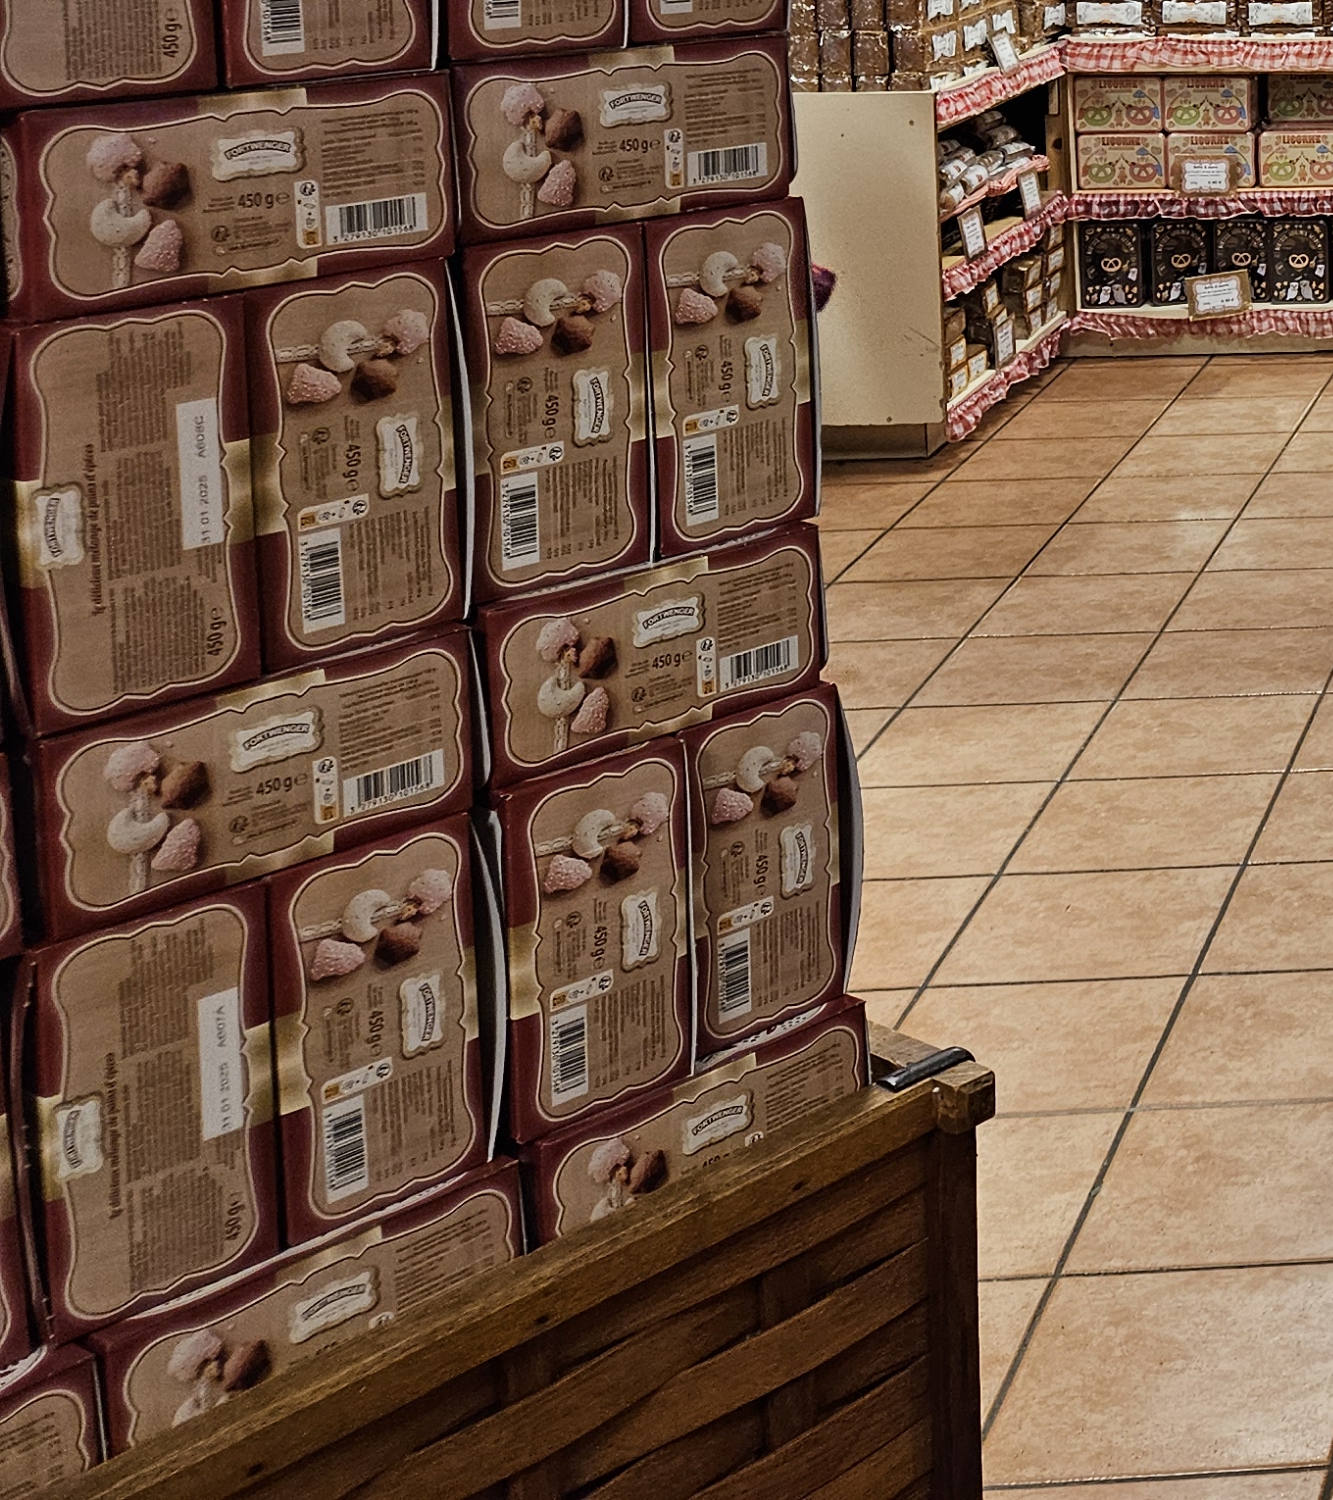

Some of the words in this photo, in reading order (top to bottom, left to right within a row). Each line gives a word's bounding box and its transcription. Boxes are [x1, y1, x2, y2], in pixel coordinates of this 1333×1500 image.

[609, 92, 662, 109] FORTWENGER
[223, 141, 292, 160] FORTWENGER
[1282, 134, 1321, 144] LICORNE
[759, 344, 772, 397] FORTWENGER
[589, 377, 603, 434] FORTWENGER
[395, 424, 411, 484] FORTWENGER
[642, 607, 695, 629] FORTWENGER
[242, 723, 311, 751] FORTWENGER
[637, 900, 651, 957] FORTWENGER
[418, 983, 434, 1042] FORTWENGER
